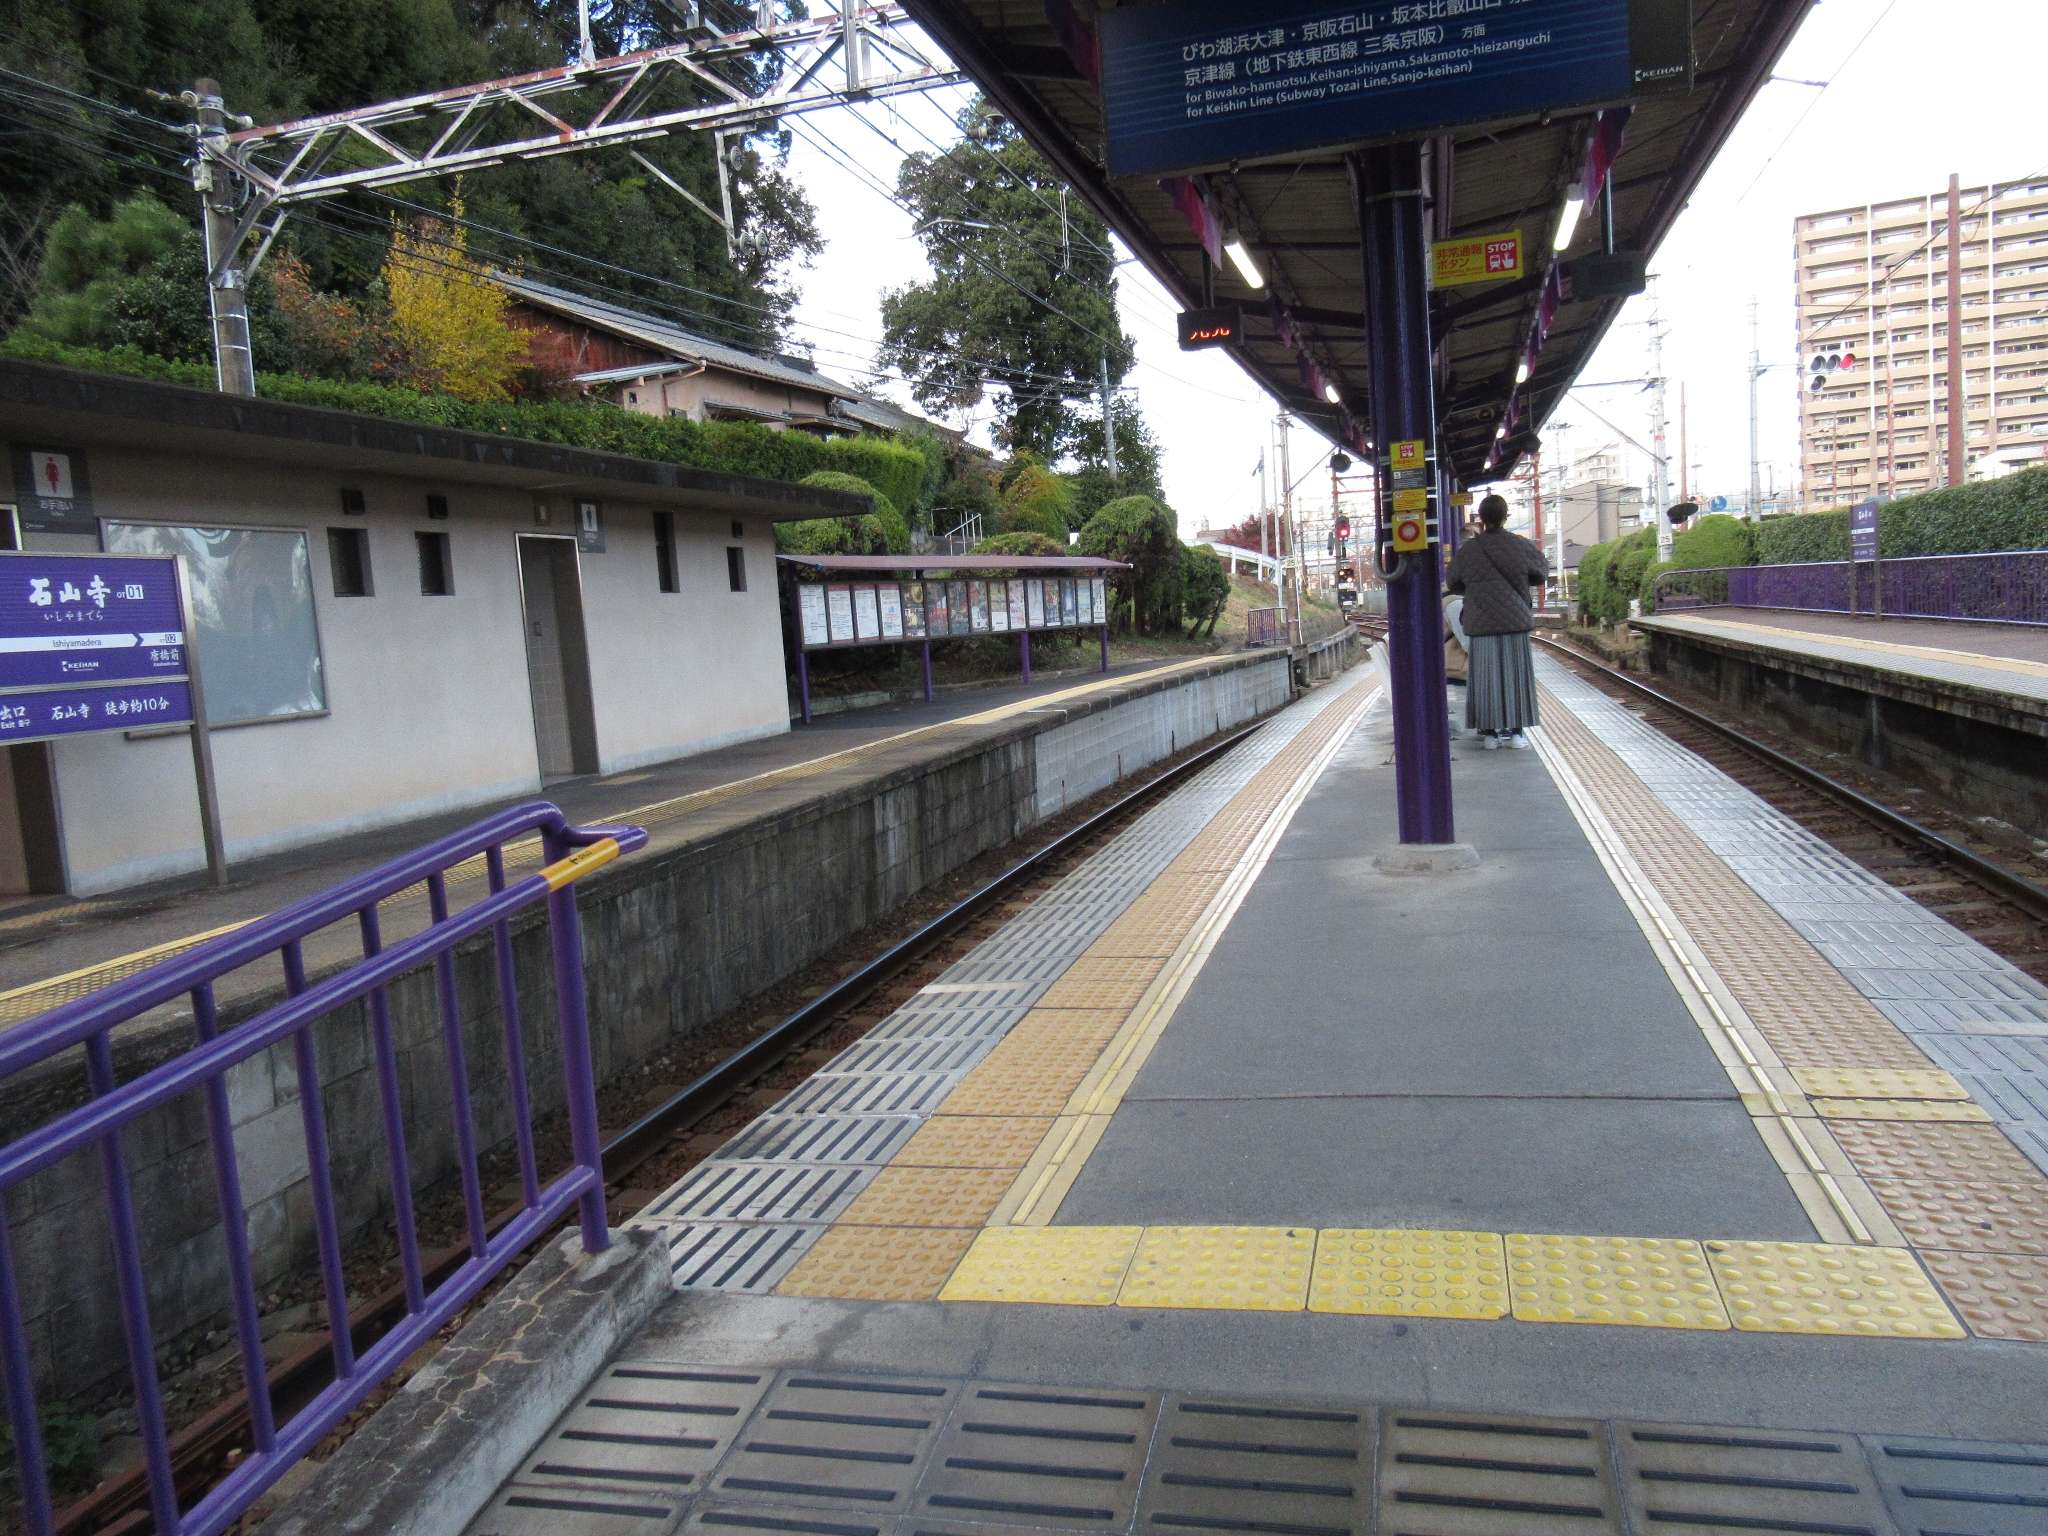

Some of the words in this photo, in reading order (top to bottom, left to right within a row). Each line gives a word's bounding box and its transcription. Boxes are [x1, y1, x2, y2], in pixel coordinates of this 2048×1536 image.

[1461, 24, 1486, 39] 方面
[1642, 65, 1684, 77] KEIHAN
[1185, 92, 1202, 103] for
[1186, 107, 1203, 118] for
[1206, 101, 1247, 115] Keishin
[1250, 95, 1273, 108] Line
[1276, 85, 1326, 105] (Subway
[1329, 81, 1359, 94] Tozai
[1487, 241, 1515, 253] STOP
[29, 574, 111, 608] 石山寺
[127, 586, 142, 599] 01
[53, 638, 102, 648] Ishiyamadera
[0, 705, 26, 720] 出口
[52, 703, 90, 720] 石山寺
